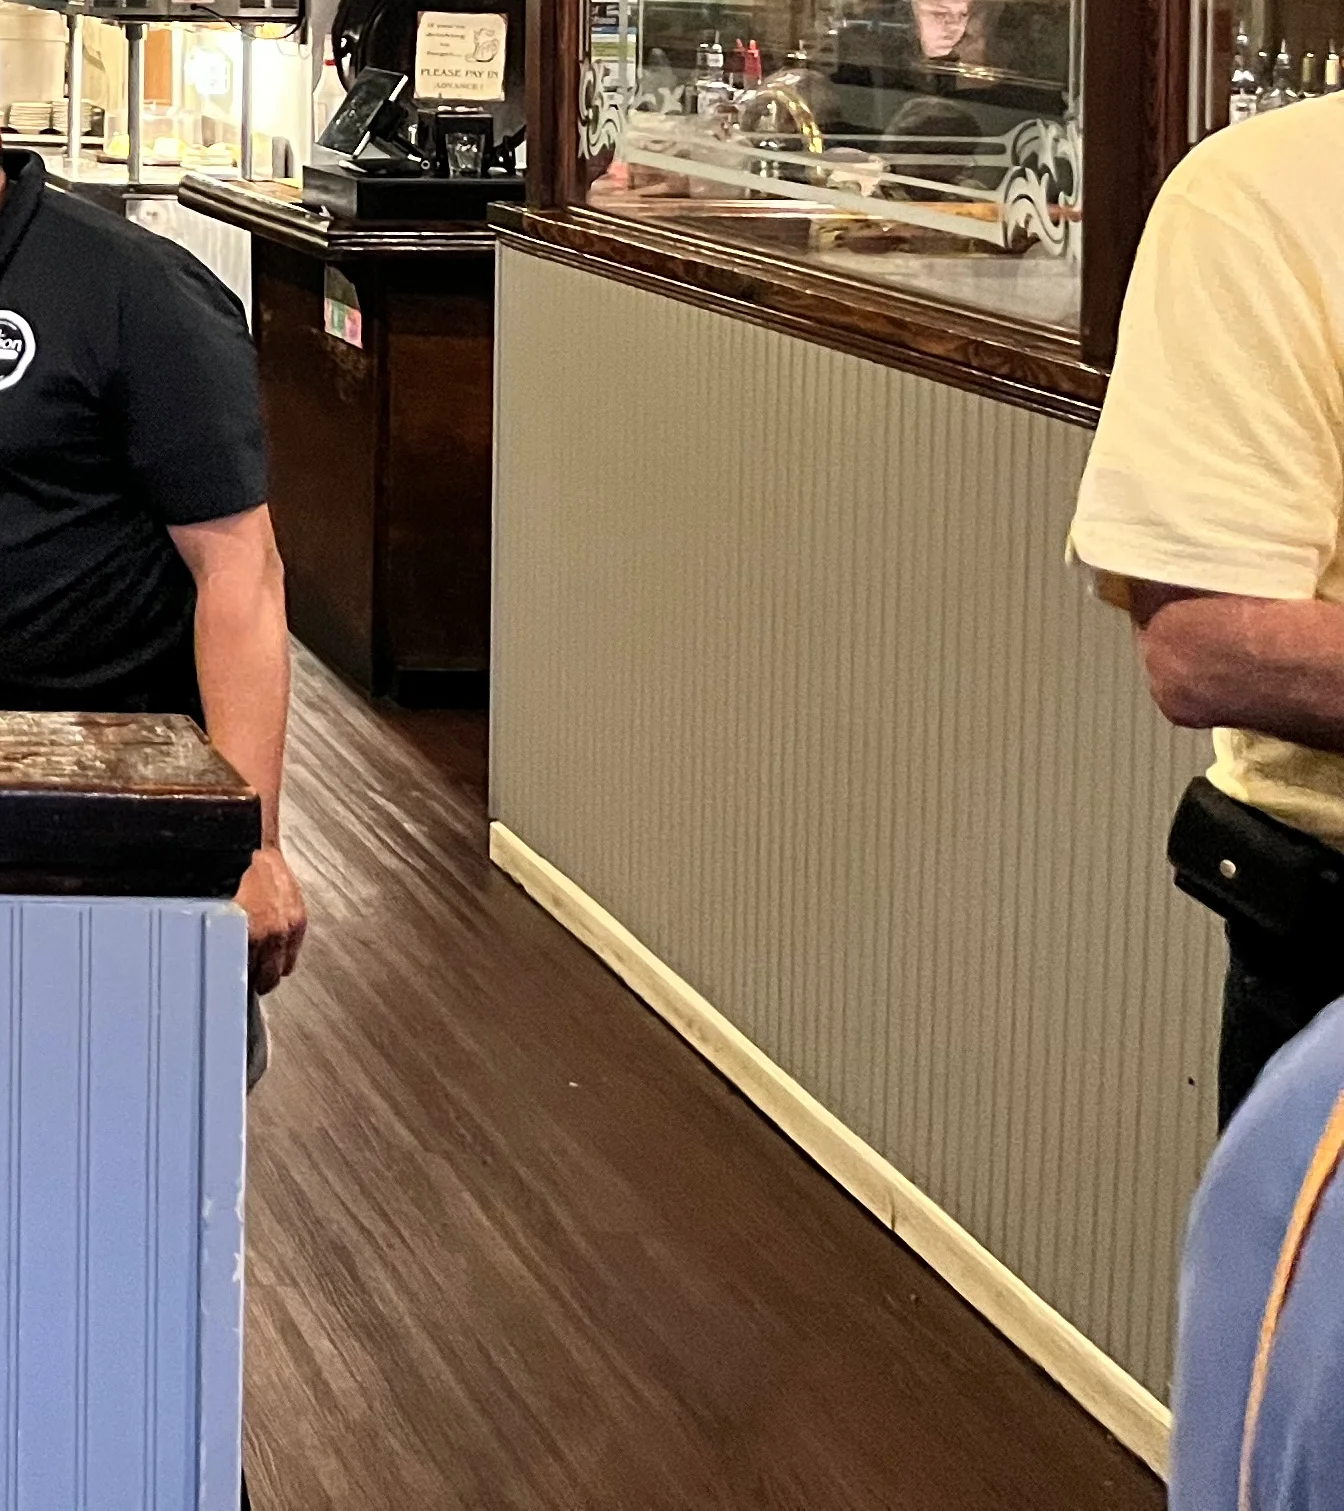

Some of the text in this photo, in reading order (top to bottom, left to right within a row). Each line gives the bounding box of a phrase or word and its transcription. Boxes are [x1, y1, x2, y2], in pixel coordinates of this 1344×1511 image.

[420, 68, 499, 79] PLEASE PAY IN
